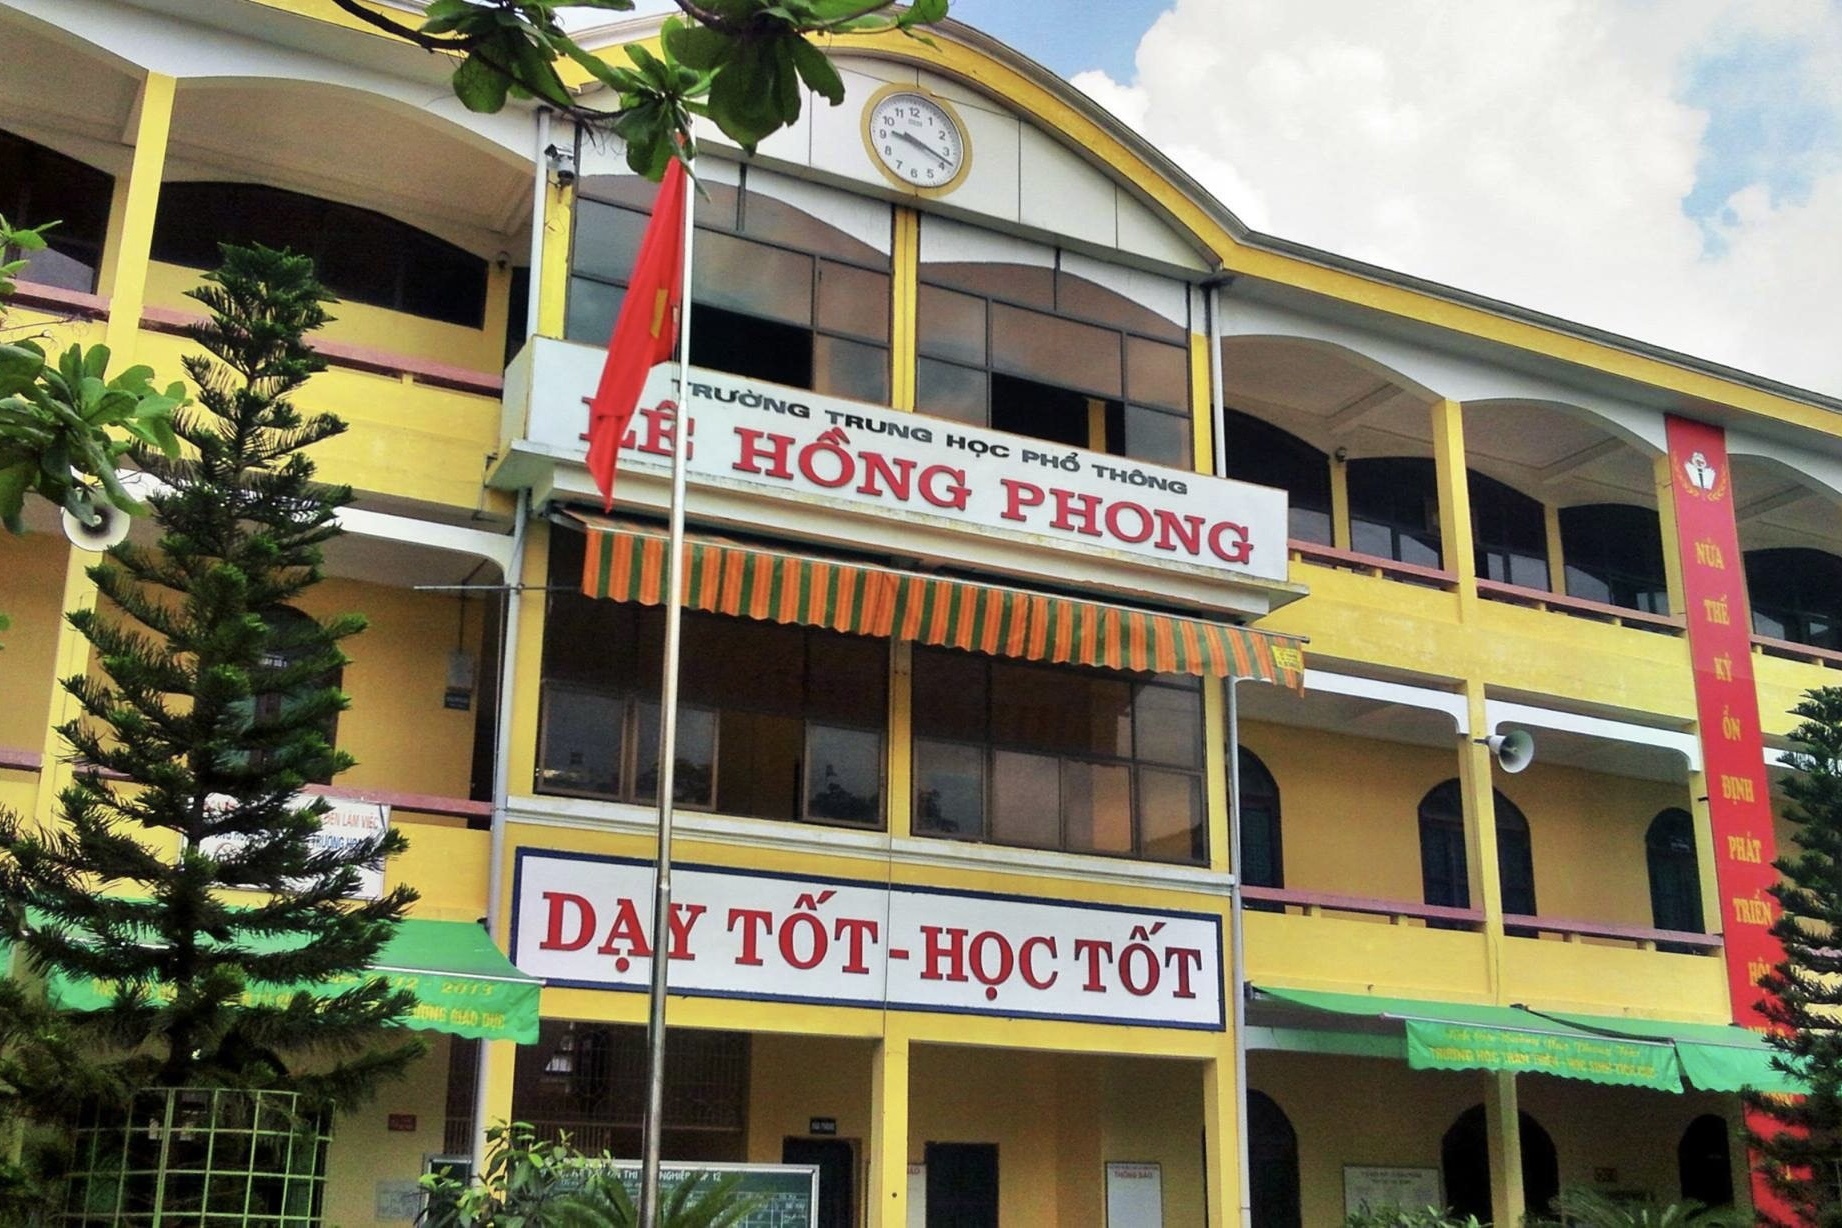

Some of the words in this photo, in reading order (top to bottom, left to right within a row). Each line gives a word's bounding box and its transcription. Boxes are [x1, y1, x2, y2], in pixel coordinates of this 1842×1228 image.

[895, 107, 904, 118] 11
[909, 107, 920, 118] 12
[883, 115, 895, 127] 10
[928, 117, 933, 126] 1
[880, 129, 887, 139] 9
[939, 130, 946, 141] 2
[884, 146, 892, 156] 8
[943, 147, 950, 157] 3
[896, 160, 903, 170] 7
[910, 168, 918, 178] 6
[927, 168, 934, 179] 5
[671, 378, 810, 419] TRƯỜNG
[824, 409, 932, 444] TRUNG
[946, 434, 1010, 459] HỌC
[1022, 451, 1080, 473] PHỔ
[1092, 464, 1188, 495] THÔNG
[732, 426, 972, 511] HỒNG
[1000, 478, 1254, 564] PHONG
[1703, 595, 1729, 625] THẾ
[1721, 775, 1755, 804] ĐỊNH
[1727, 832, 1762, 864] PHÁT
[1732, 889, 1772, 925] TRIỂN
[540, 891, 707, 973] DẠY
[727, 890, 879, 975] TỐT
[920, 925, 1059, 1001] HỌC
[1074, 921, 1203, 999] TỐT
